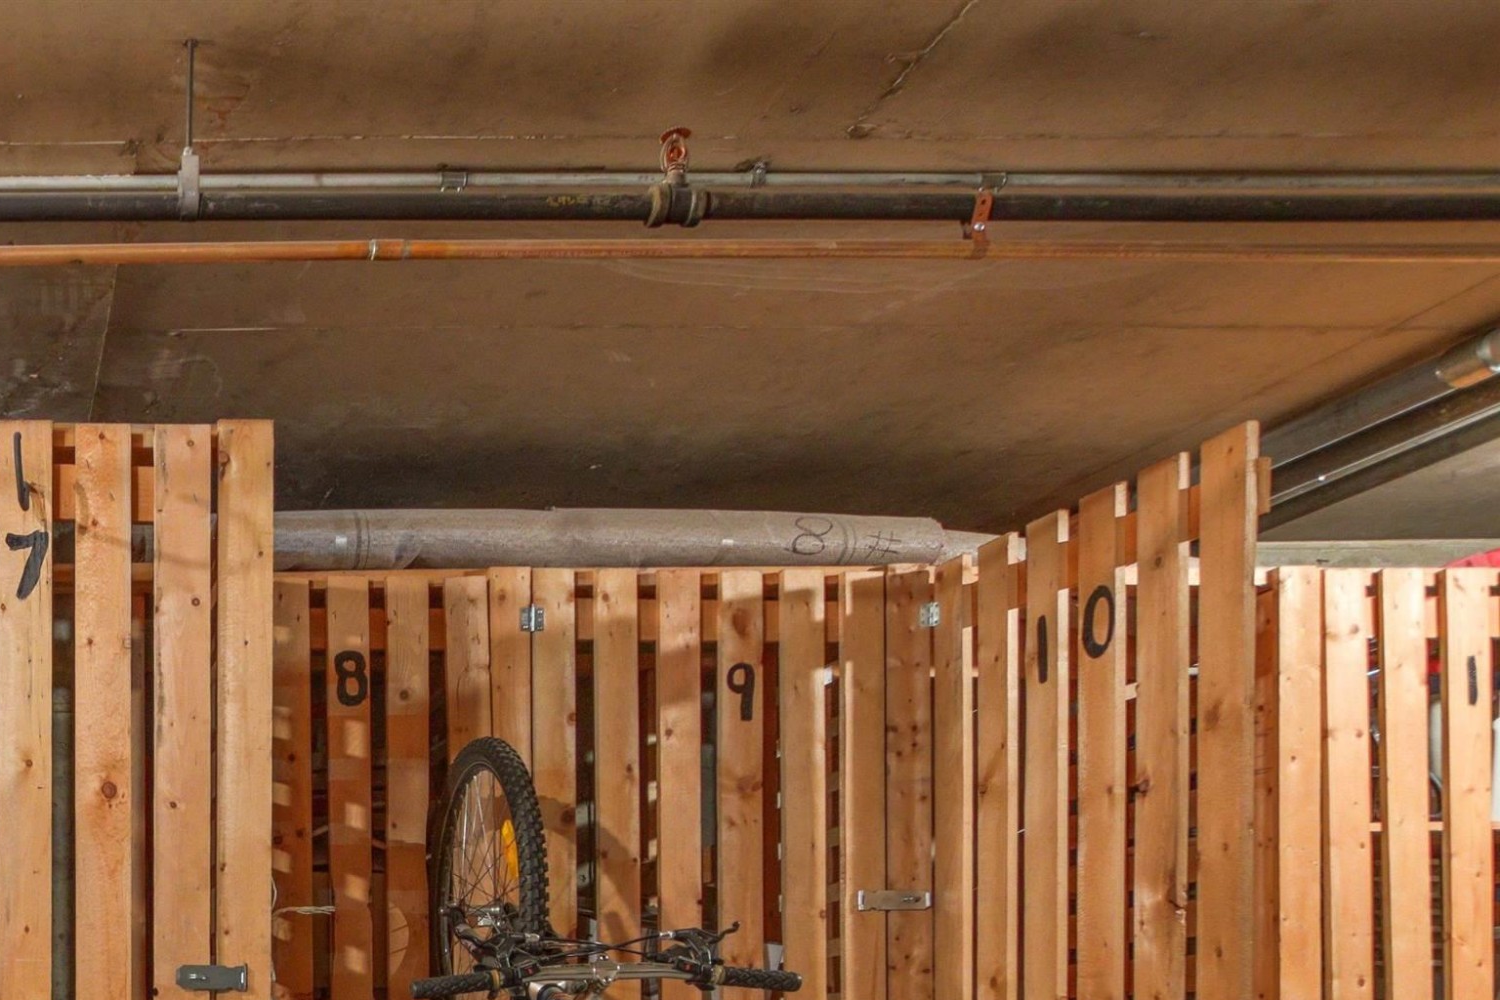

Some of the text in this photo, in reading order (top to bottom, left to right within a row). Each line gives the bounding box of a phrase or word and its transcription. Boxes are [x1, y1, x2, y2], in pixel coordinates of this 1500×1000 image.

[5, 530, 49, 600] 7
[1037, 585, 1116, 684] 10
[334, 650, 368, 706] 8
[726, 661, 756, 721] 9
